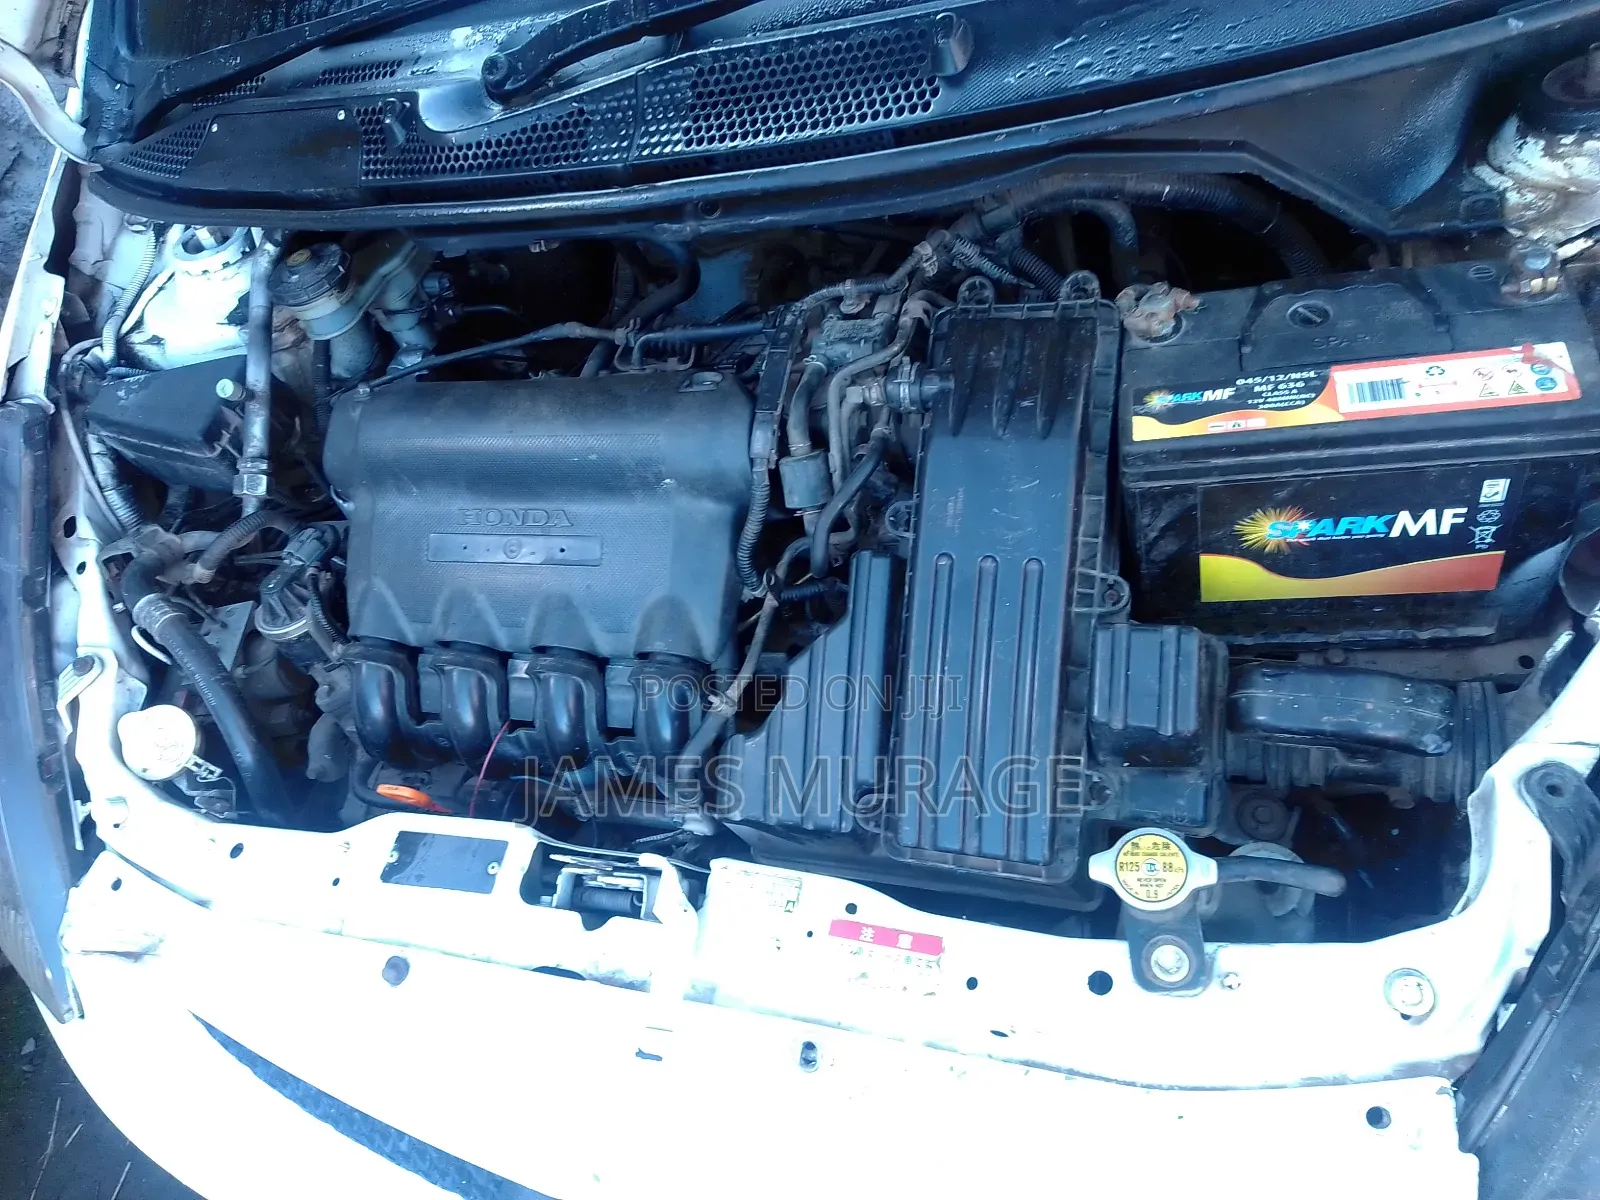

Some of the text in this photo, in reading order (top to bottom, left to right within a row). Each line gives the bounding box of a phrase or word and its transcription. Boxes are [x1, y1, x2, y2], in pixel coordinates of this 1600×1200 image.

[1254, 381, 1306, 392] MF 636
[457, 508, 574, 527] HONDA
[1118, 861, 1140, 872] R125
